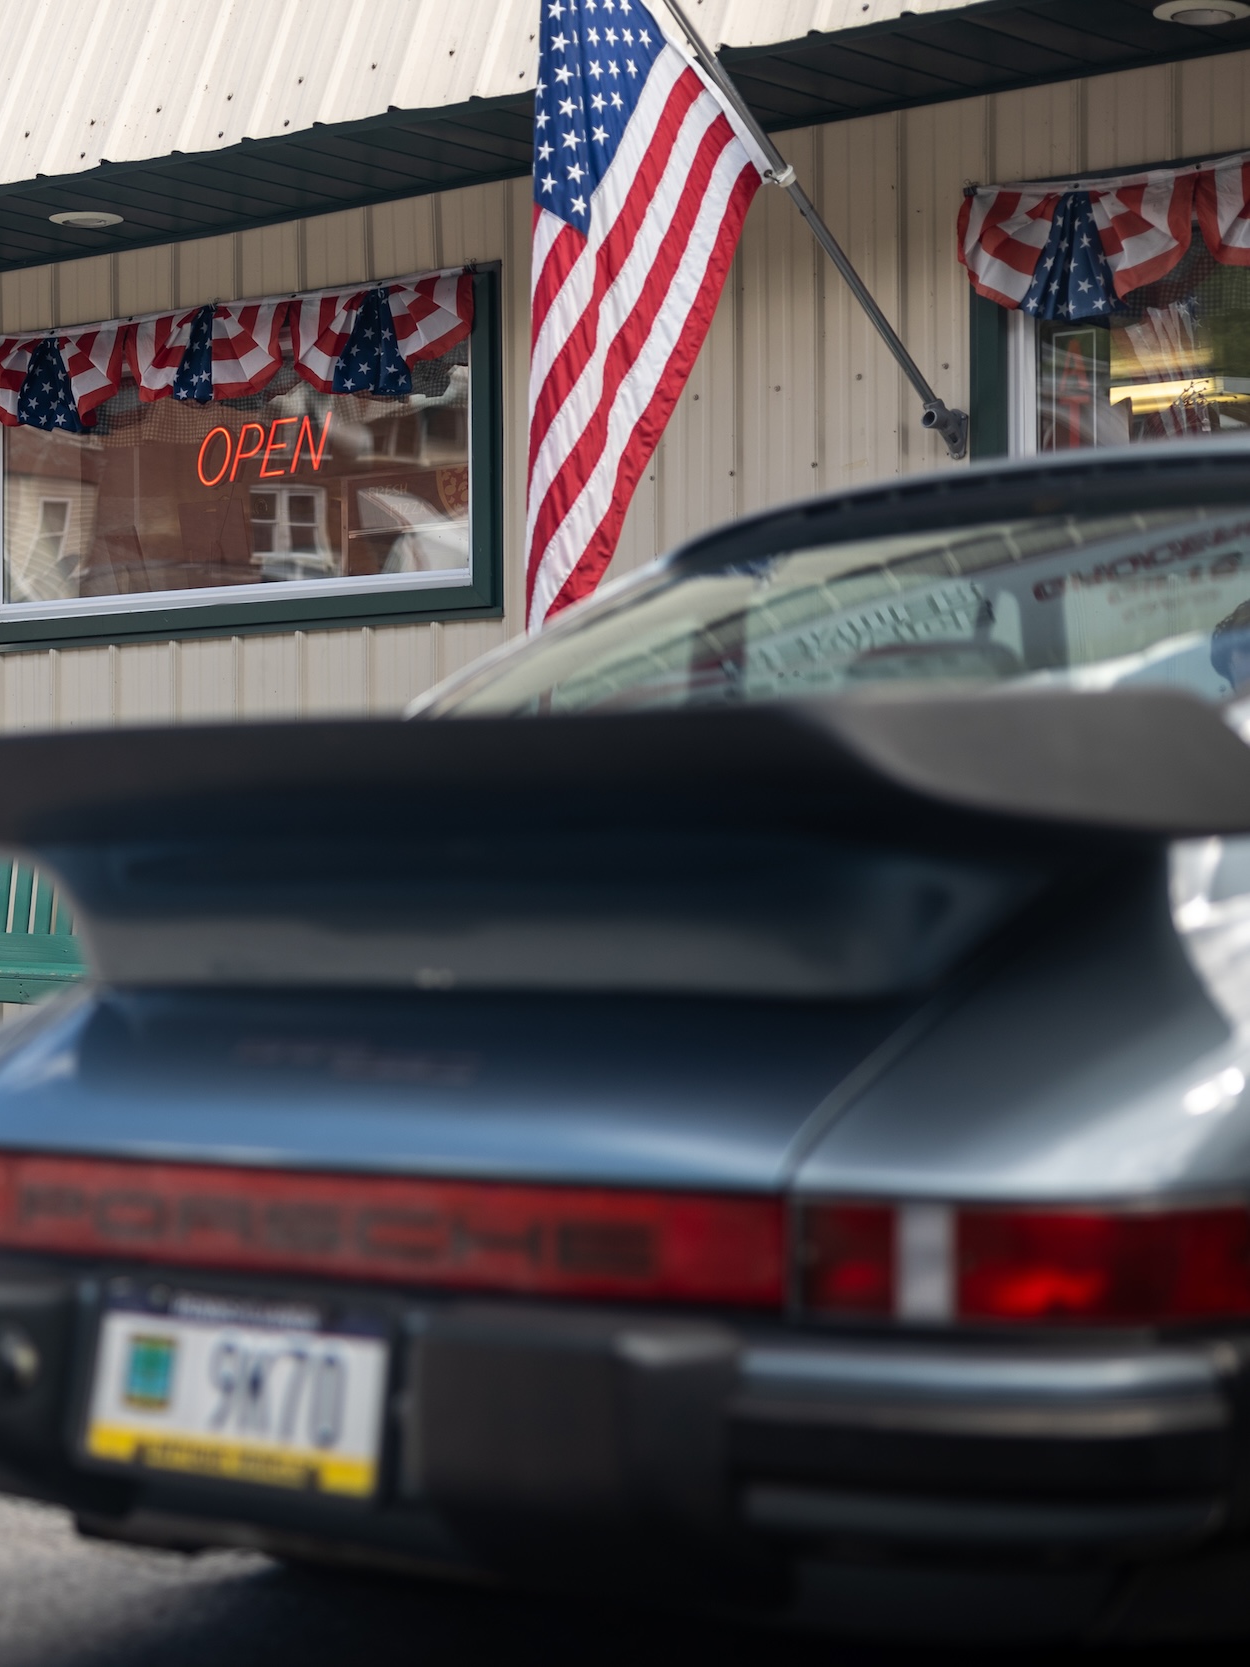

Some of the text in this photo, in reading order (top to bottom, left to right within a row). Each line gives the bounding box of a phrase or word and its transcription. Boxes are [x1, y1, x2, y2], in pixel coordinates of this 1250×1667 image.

[197, 411, 333, 486] OPEN
[389, 502, 428, 517] PIZZA
[17, 1182, 660, 1277] PORSCHE
[207, 1327, 349, 1451] 9K70
